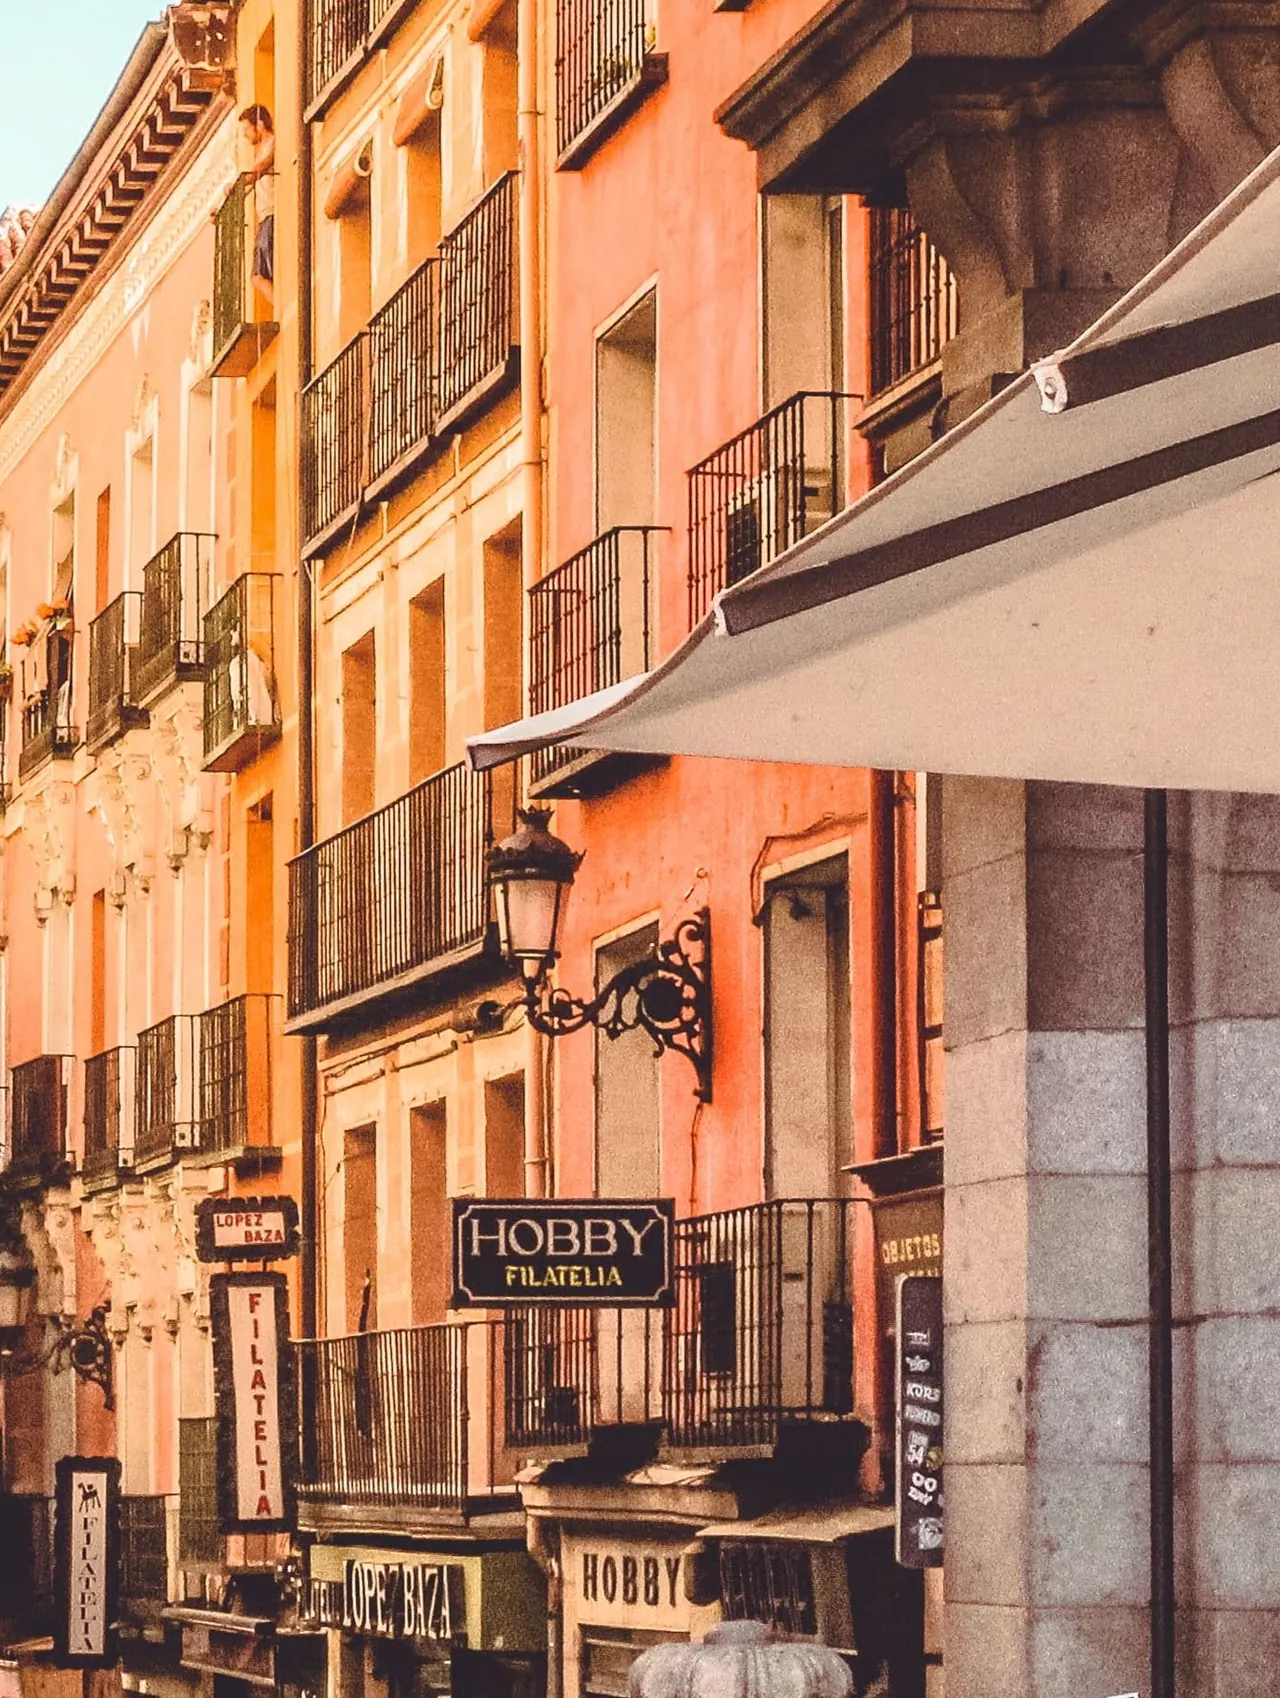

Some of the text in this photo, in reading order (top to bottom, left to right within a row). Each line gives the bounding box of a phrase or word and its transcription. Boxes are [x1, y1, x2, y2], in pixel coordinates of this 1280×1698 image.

[216, 1213, 263, 1227] LOPEZ
[244, 1229, 284, 1243] BAZA
[470, 1218, 658, 1257] HOBBY
[882, 1233, 941, 1264] OBJETOS
[505, 1265, 622, 1287] FILATELIA
[249, 1292, 272, 1516] FILATELIA
[78, 1516, 98, 1651] FILATELIA
[343, 1559, 400, 1639] LOPEZ
[402, 1563, 452, 1640] BAZA
[583, 1553, 680, 1608] HOBBY
